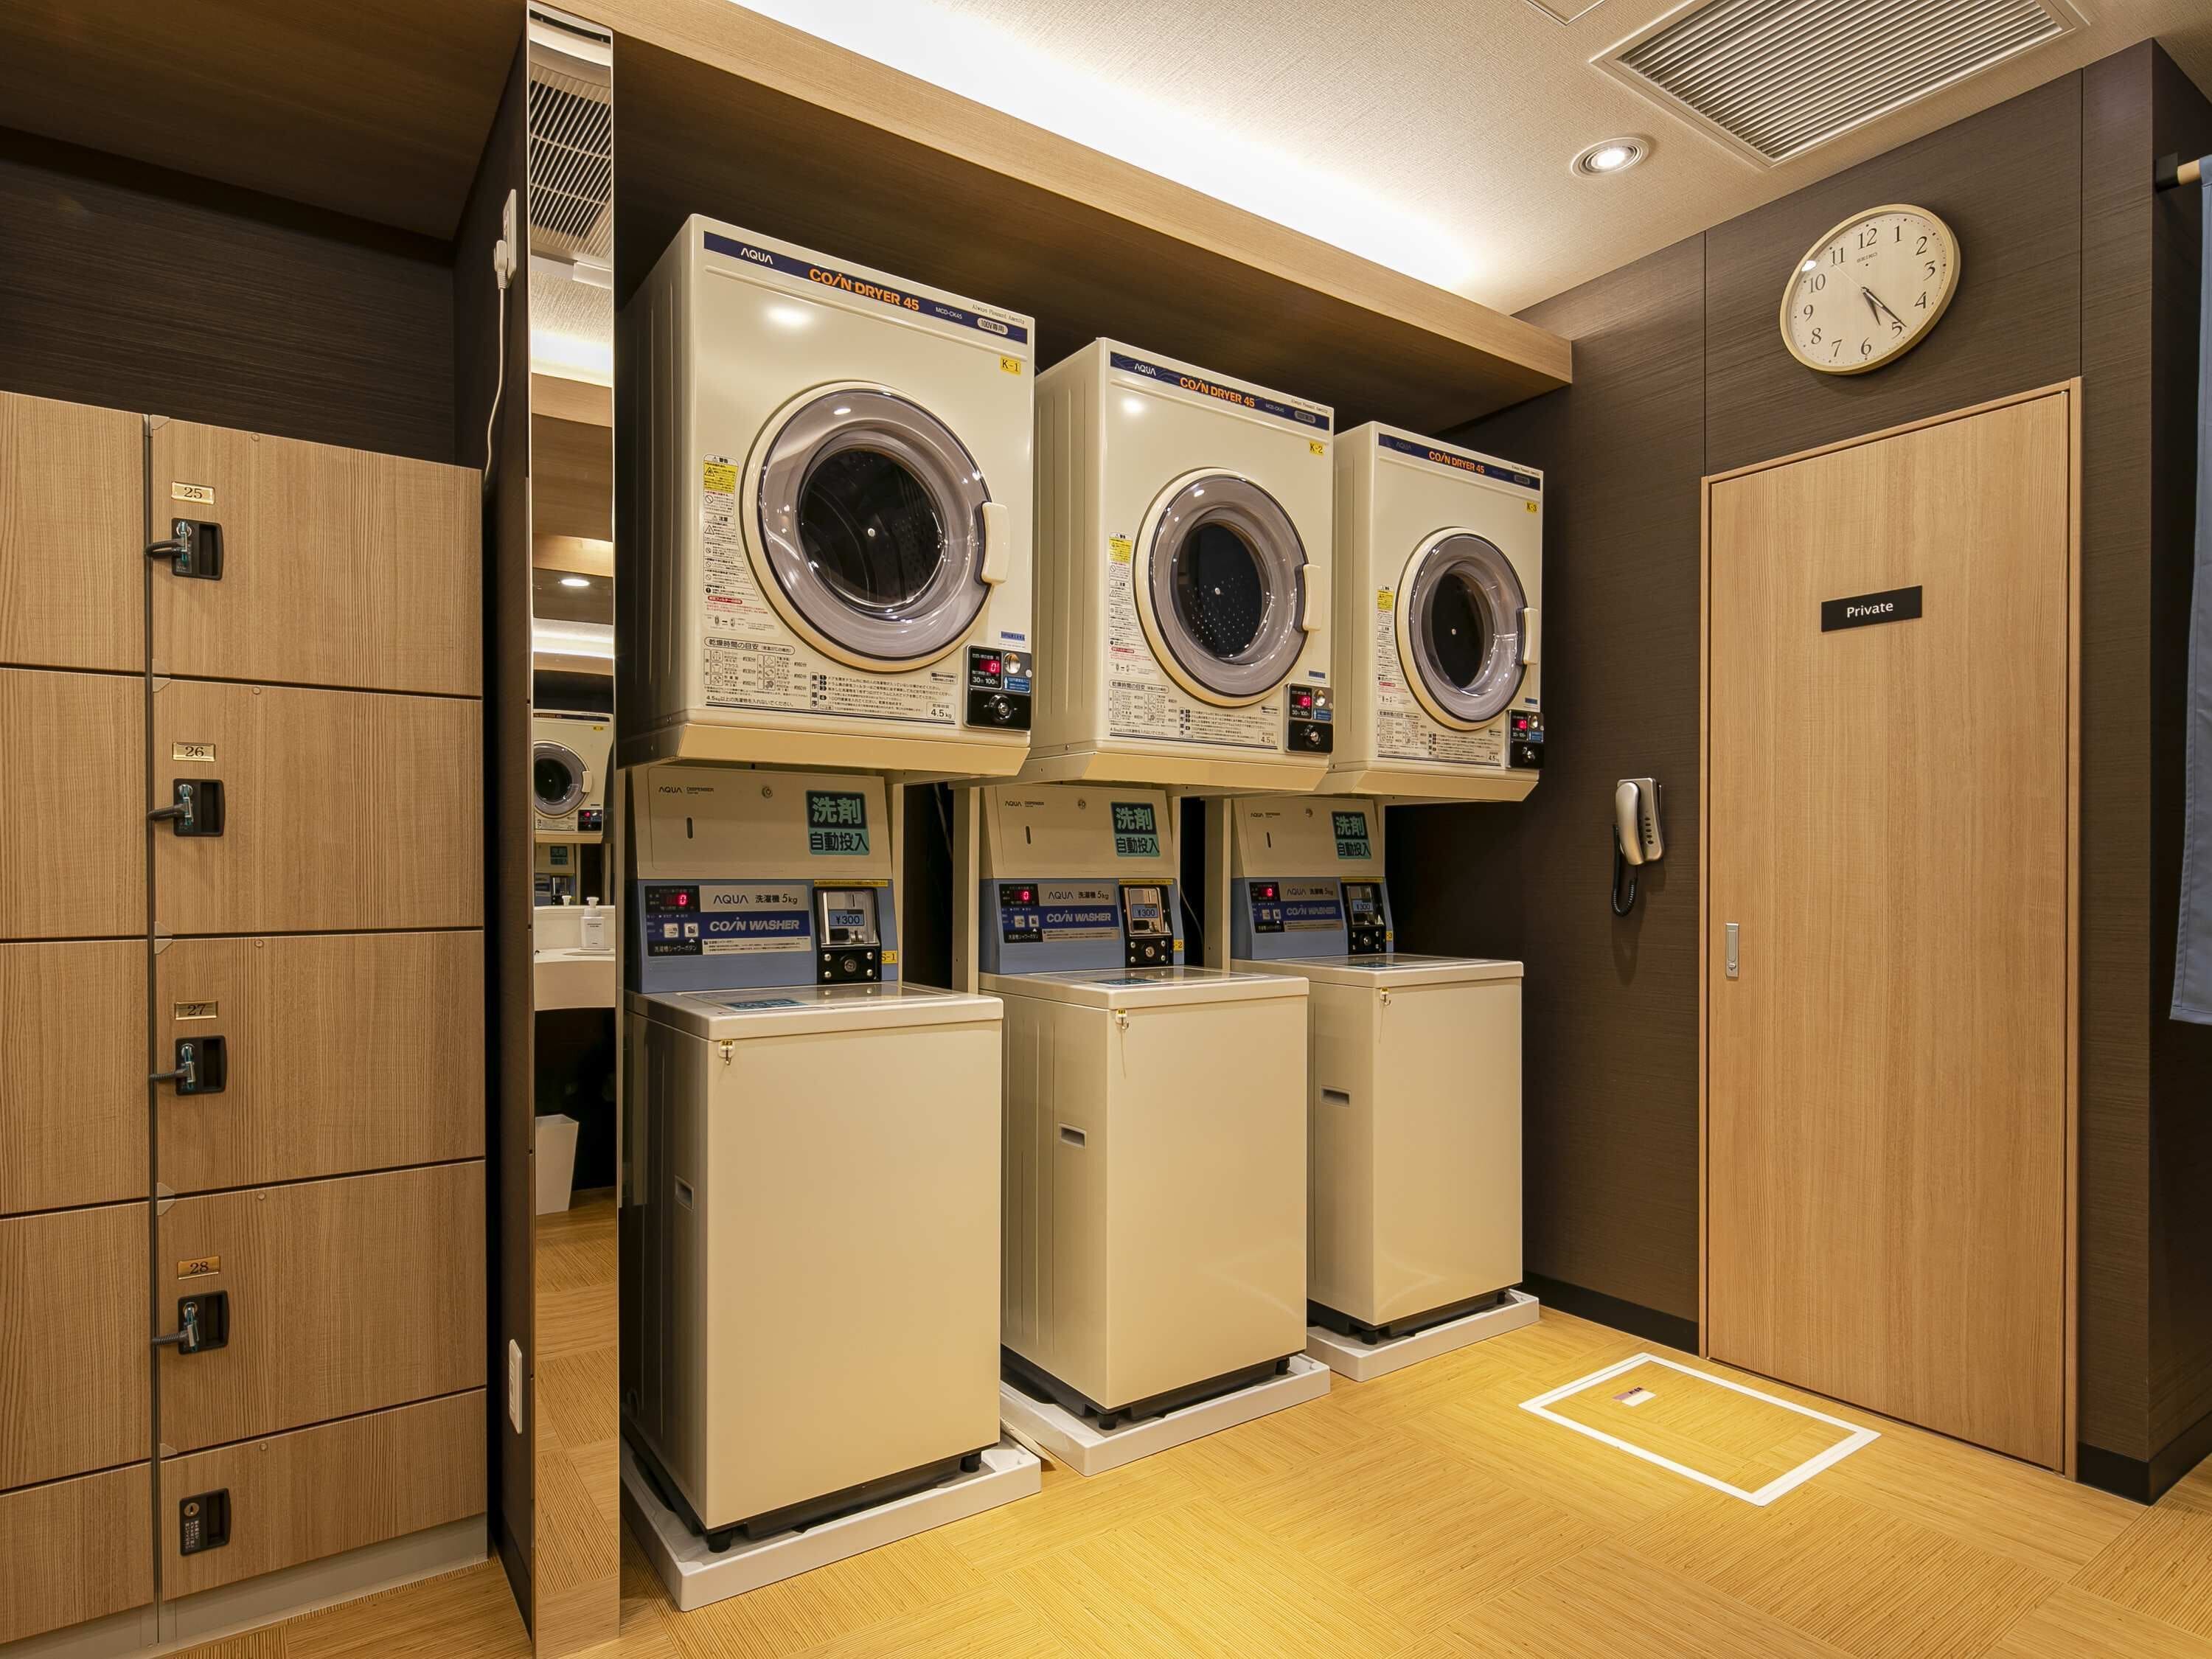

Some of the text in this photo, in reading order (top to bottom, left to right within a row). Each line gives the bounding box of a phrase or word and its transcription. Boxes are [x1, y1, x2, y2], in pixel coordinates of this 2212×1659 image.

[1857, 226, 1878, 251] 12
[1893, 225, 1902, 243] 1
[1915, 235, 1928, 256] 2
[740, 247, 773, 265] AQUA
[1830, 247, 1846, 267] 11
[1856, 251, 1878, 264] SEIKO
[1922, 260, 1936, 281] 3
[810, 268, 920, 311] COIN DRYER 45
[1808, 274, 1826, 295] 10
[1914, 291, 1927, 310] 4
[1803, 303, 1815, 322] 9
[1810, 327, 1823, 345] 8
[1891, 320, 1904, 339] 5
[1830, 338, 1843, 358] 7
[1860, 336, 1872, 356] 6
[1002, 358, 1020, 372] K-1
[1134, 363, 1156, 377] AQUA
[1180, 377, 1255, 408] COIN DRYER 45
[1310, 442, 1324, 454] K-2
[1428, 449, 1451, 466] COIN
[1451, 457, 1475, 471] DRYER
[1476, 464, 1485, 474] 45
[184, 487, 203, 499] 25
[1846, 602, 1893, 619] Private
[990, 663, 998, 672] 0
[185, 745, 204, 757] 26
[813, 796, 862, 824] 洗剤
[1116, 807, 1152, 830] 洗剤
[1335, 815, 1366, 836] 洗剤
[810, 832, 869, 852] 自動投入
[1116, 837, 1160, 854] 自動投入
[1338, 842, 1371, 857] 自動投入
[679, 894, 687, 905] 0
[713, 894, 749, 905] AQUA
[782, 893, 798, 905] 5kg
[1023, 891, 1029, 900] 0
[1048, 891, 1074, 900] AQUA
[1286, 888, 1307, 896] AQUA
[836, 915, 860, 925] ¥300
[1046, 909, 1111, 922] COIN WASHER
[1137, 908, 1156, 917] ¥300
[709, 917, 800, 931] COIN WASHER
[881, 952, 895, 961] S-1
[187, 1004, 206, 1016] 27
[189, 1261, 209, 1275] 28
